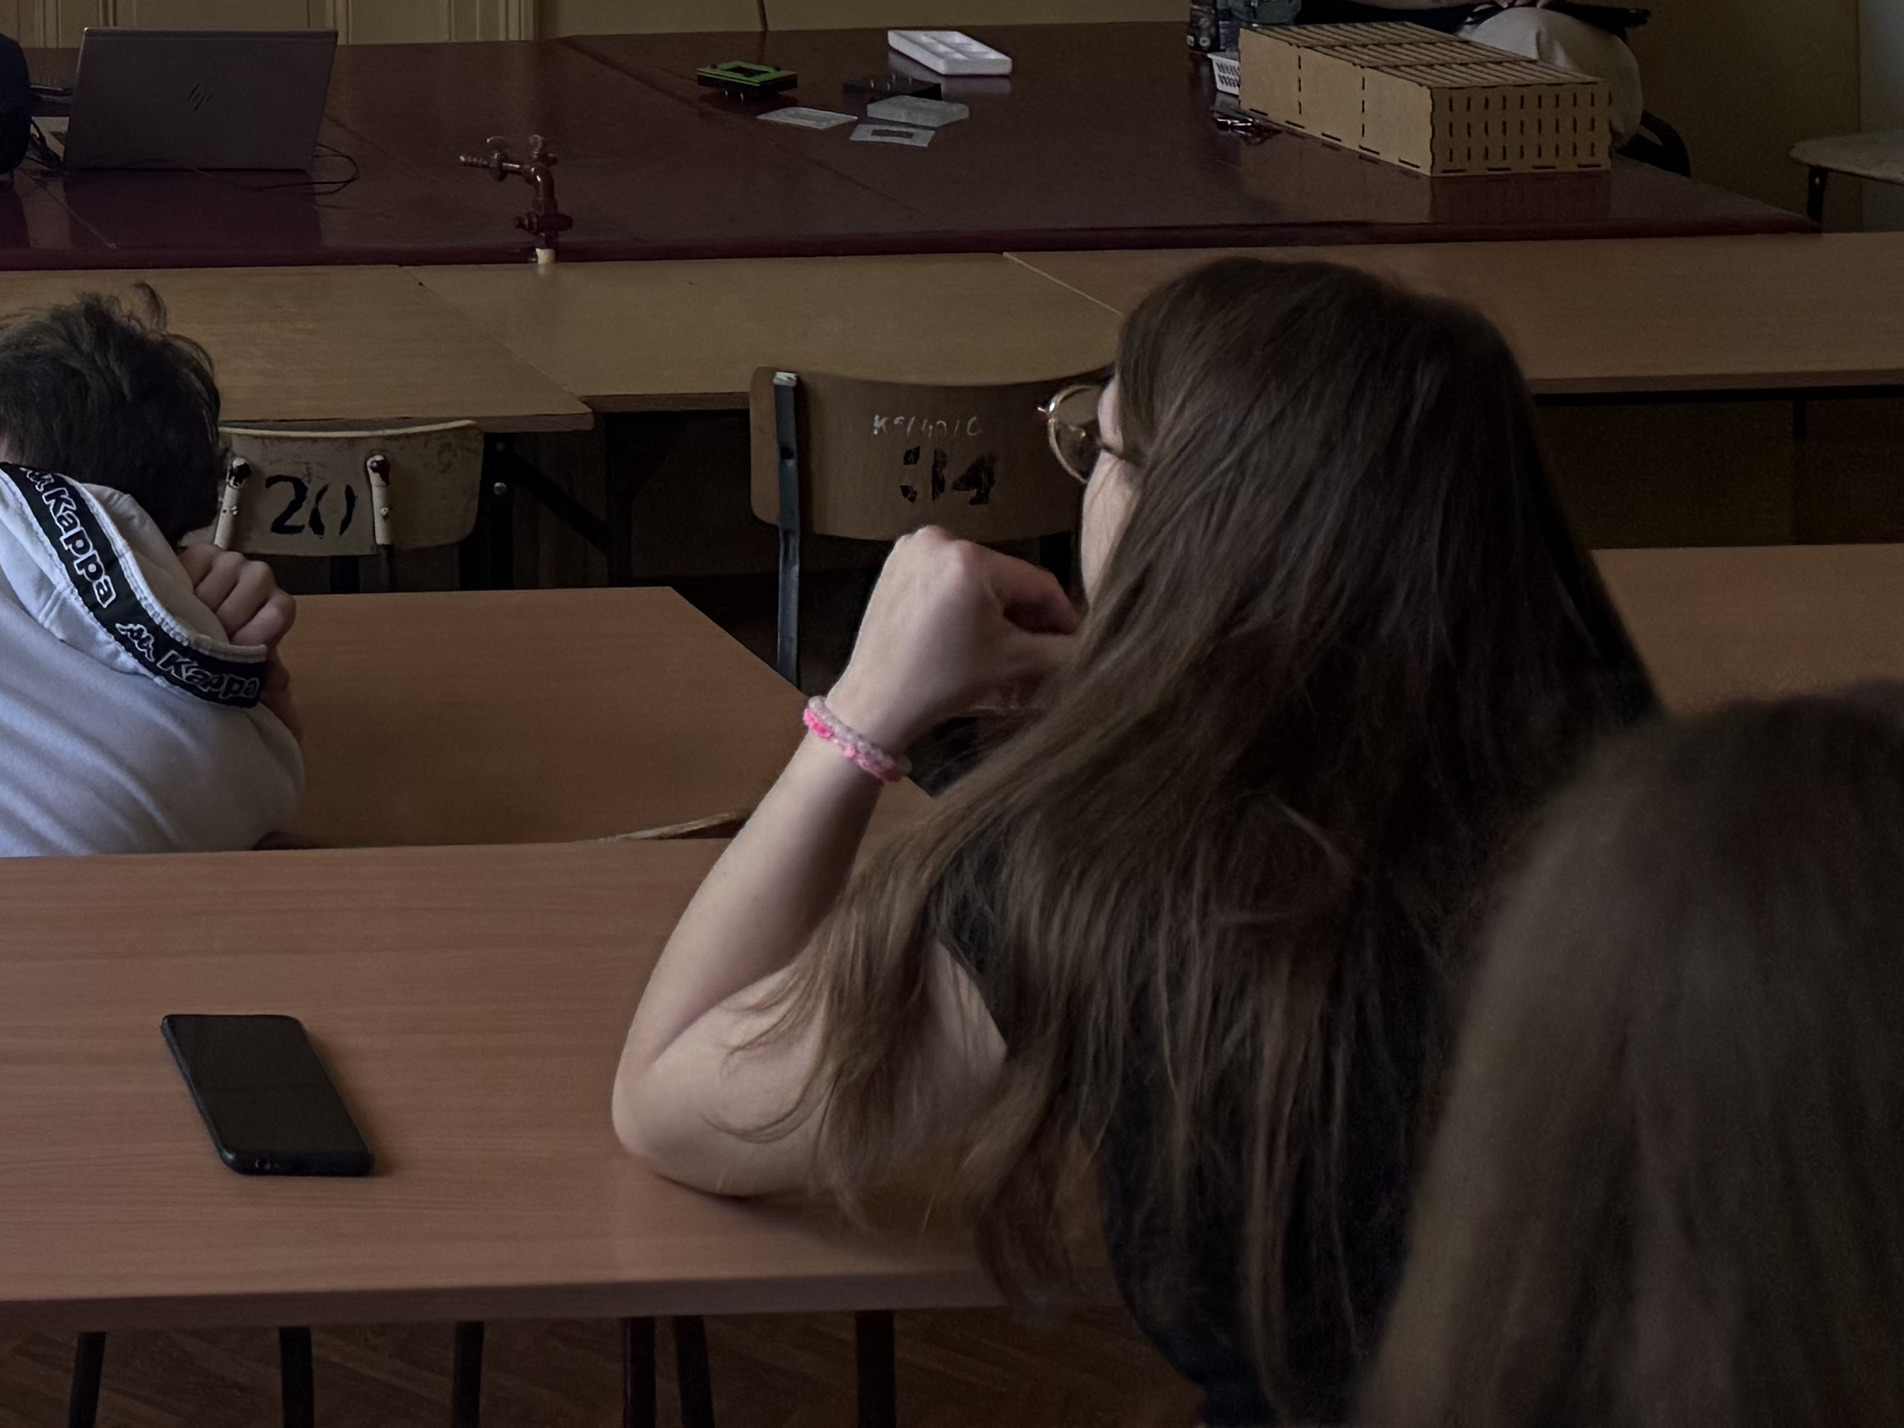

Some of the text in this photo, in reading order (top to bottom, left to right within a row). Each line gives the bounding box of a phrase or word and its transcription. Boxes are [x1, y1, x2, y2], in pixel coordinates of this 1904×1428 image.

[265, 474, 357, 538] 20
[41, 486, 117, 609] Kappa
[156, 649, 261, 699] Kappa
